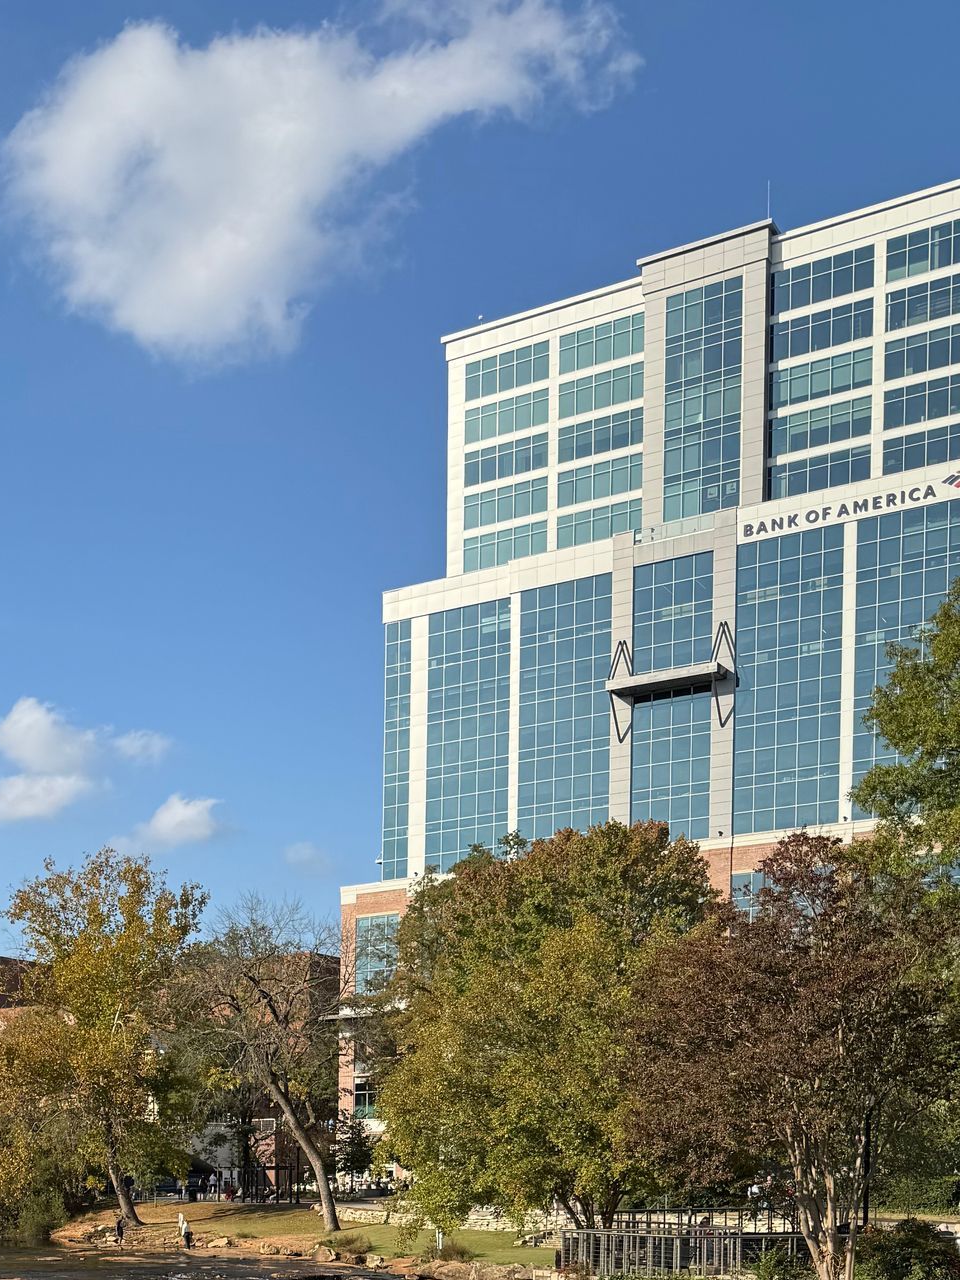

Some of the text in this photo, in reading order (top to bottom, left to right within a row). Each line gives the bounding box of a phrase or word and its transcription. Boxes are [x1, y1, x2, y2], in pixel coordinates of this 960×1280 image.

[743, 485, 937, 537] BANK OF AMERICA
